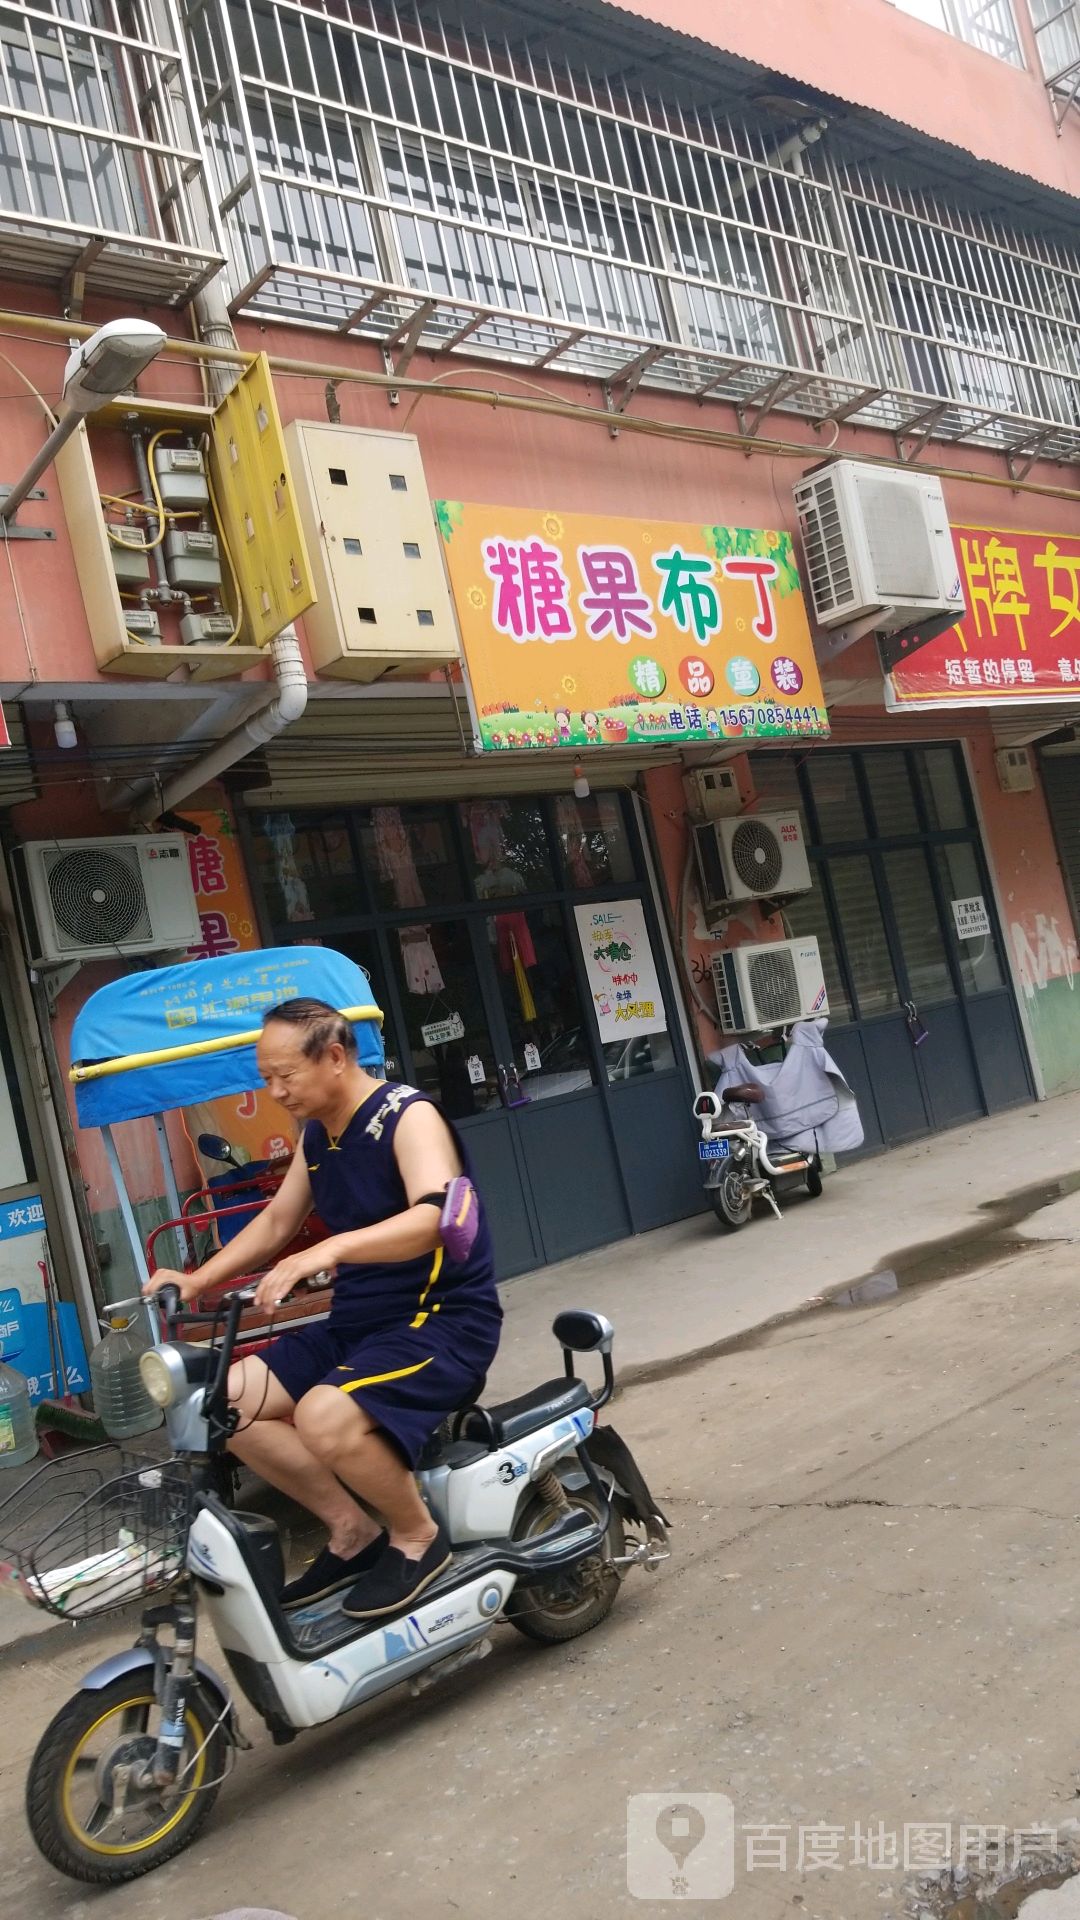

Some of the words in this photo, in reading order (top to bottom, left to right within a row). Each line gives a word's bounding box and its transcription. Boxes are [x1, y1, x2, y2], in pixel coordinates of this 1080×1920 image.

[483, 537, 778, 644] 糖果布丁
[952, 536, 1080, 652] 牌女
[632, 658, 801, 694] 精品童装
[720, 706, 819, 727] 15670854441
[780, 824, 797, 833] AUX
[592, 913, 620, 926] SALE
[612, 972, 638, 986] 特价中
